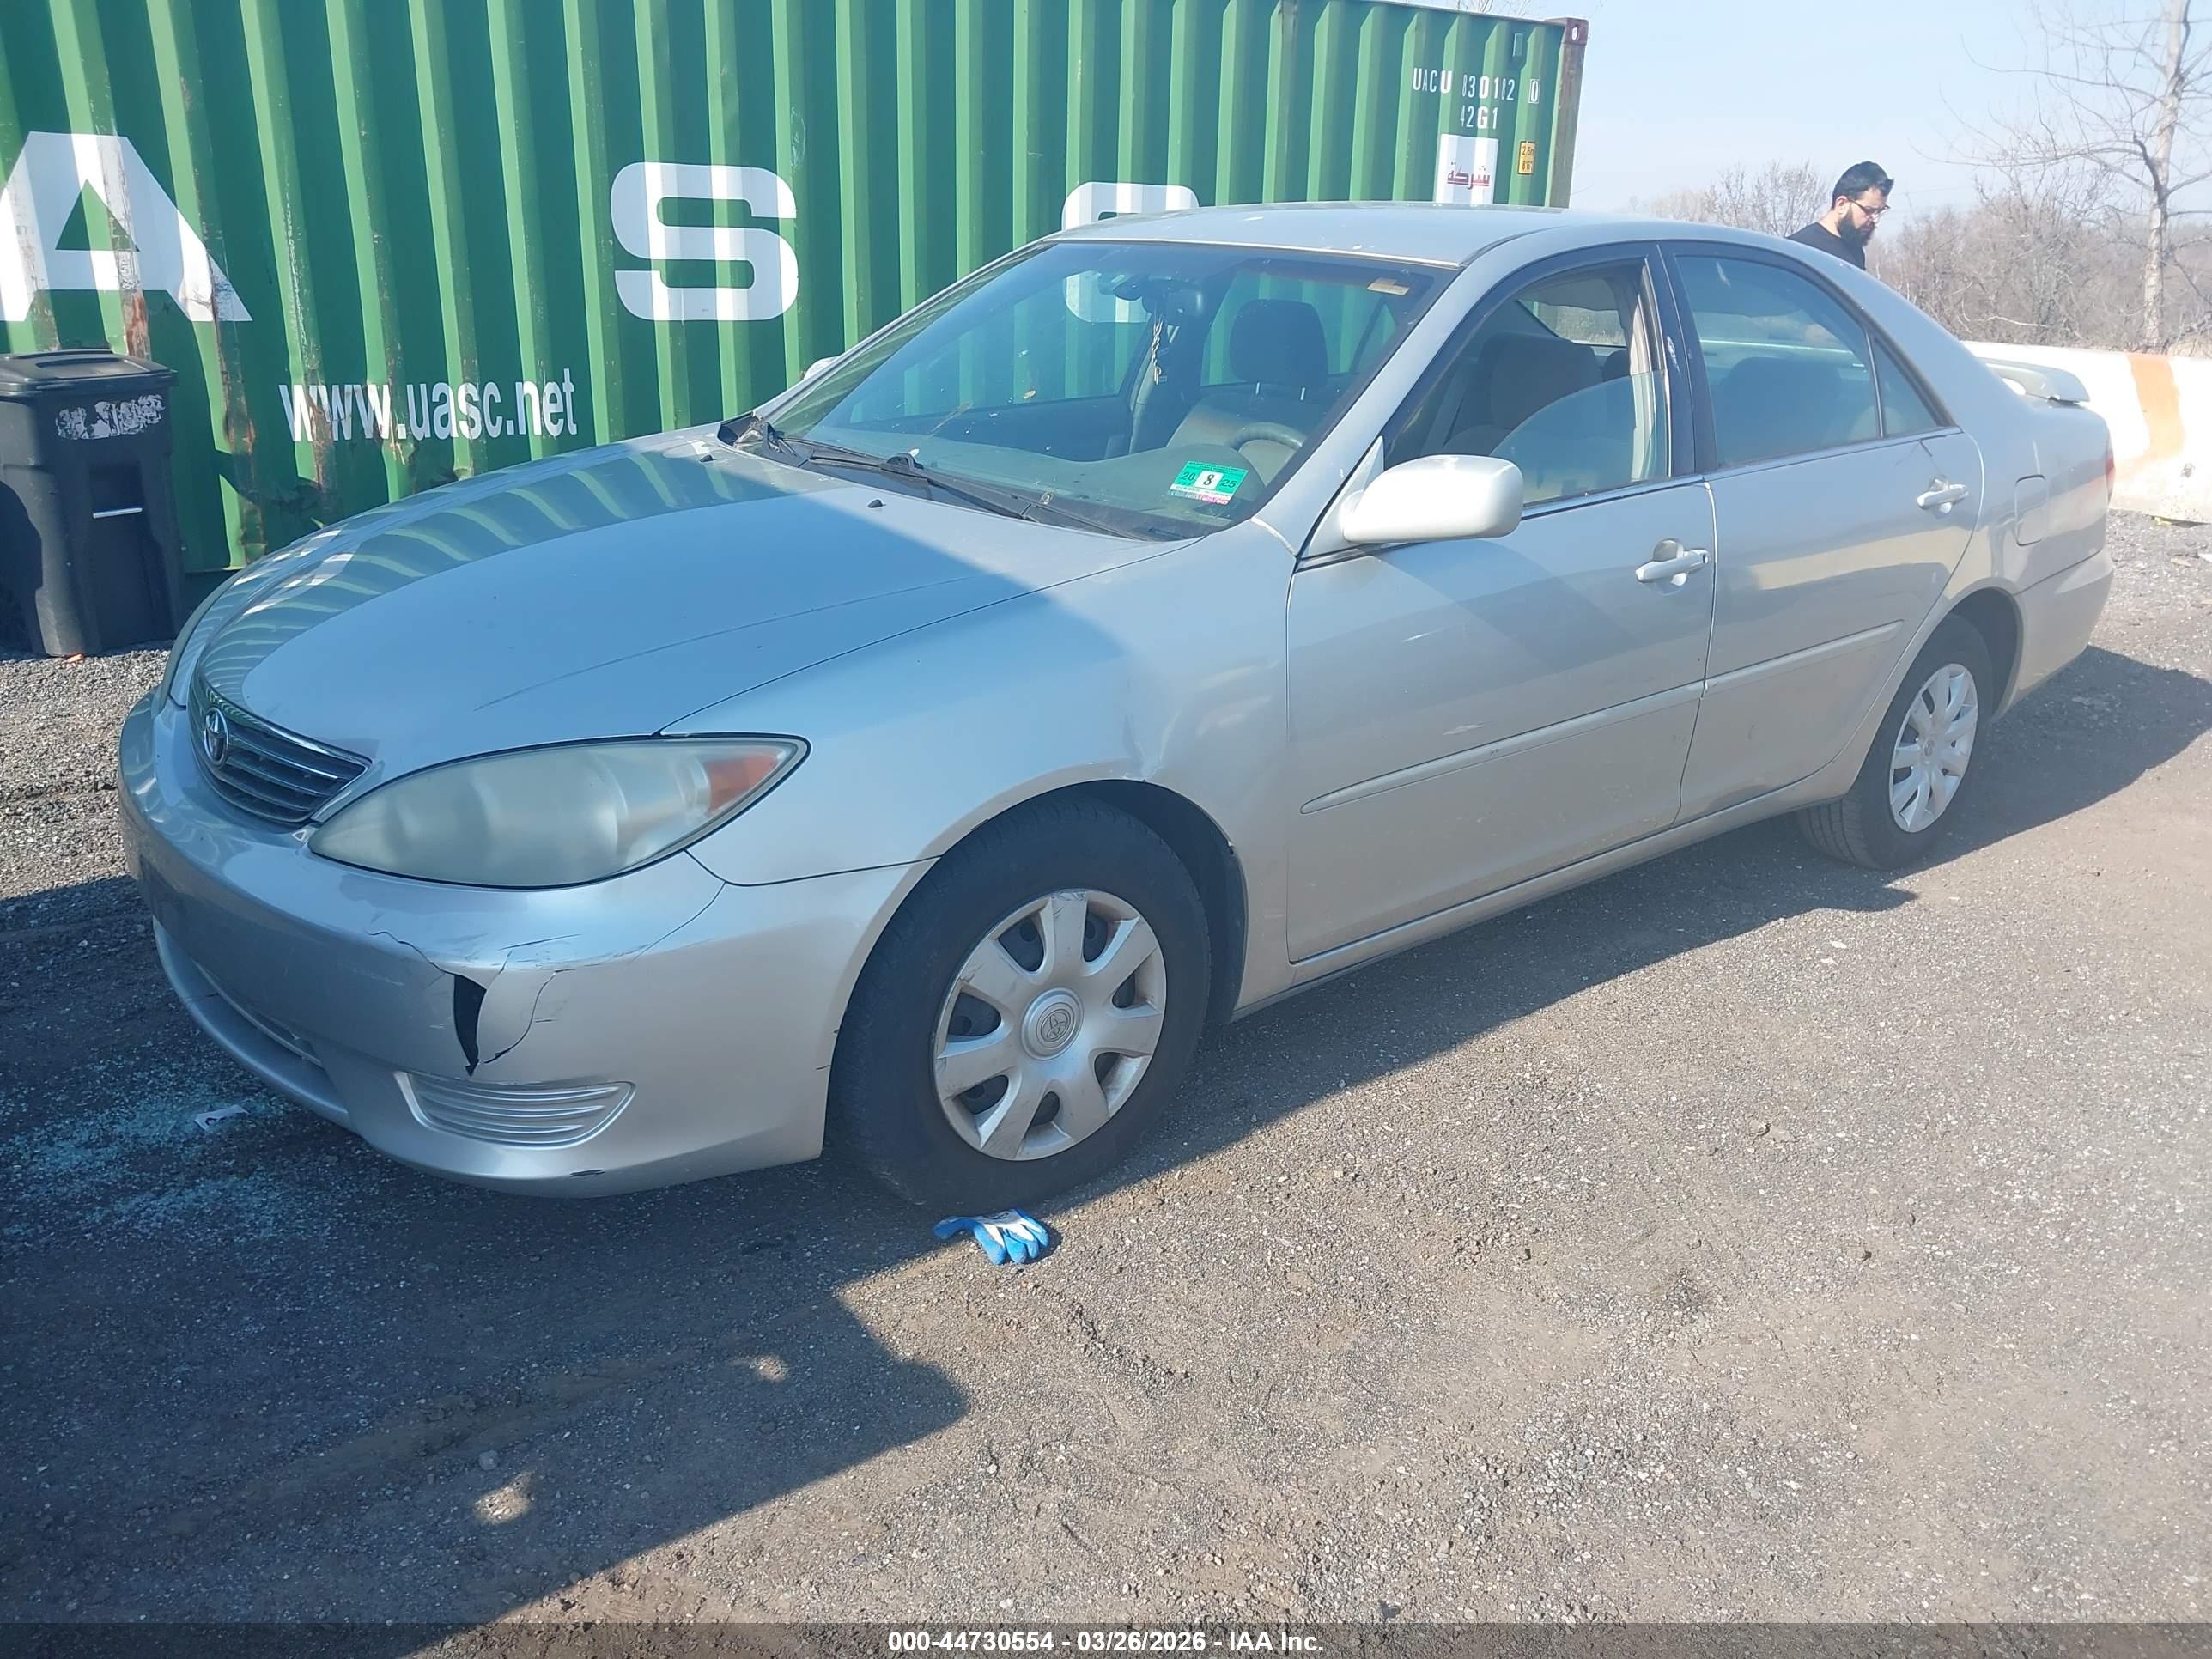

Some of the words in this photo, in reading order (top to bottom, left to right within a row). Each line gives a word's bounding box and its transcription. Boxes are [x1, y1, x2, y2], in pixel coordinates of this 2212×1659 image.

[1413, 68, 1453, 94] UACU
[1460, 105, 1498, 130] 42G1
[279, 368, 578, 442] www.uasc.net
[1181, 472, 1195, 481] 20
[1203, 474, 1214, 485] 8
